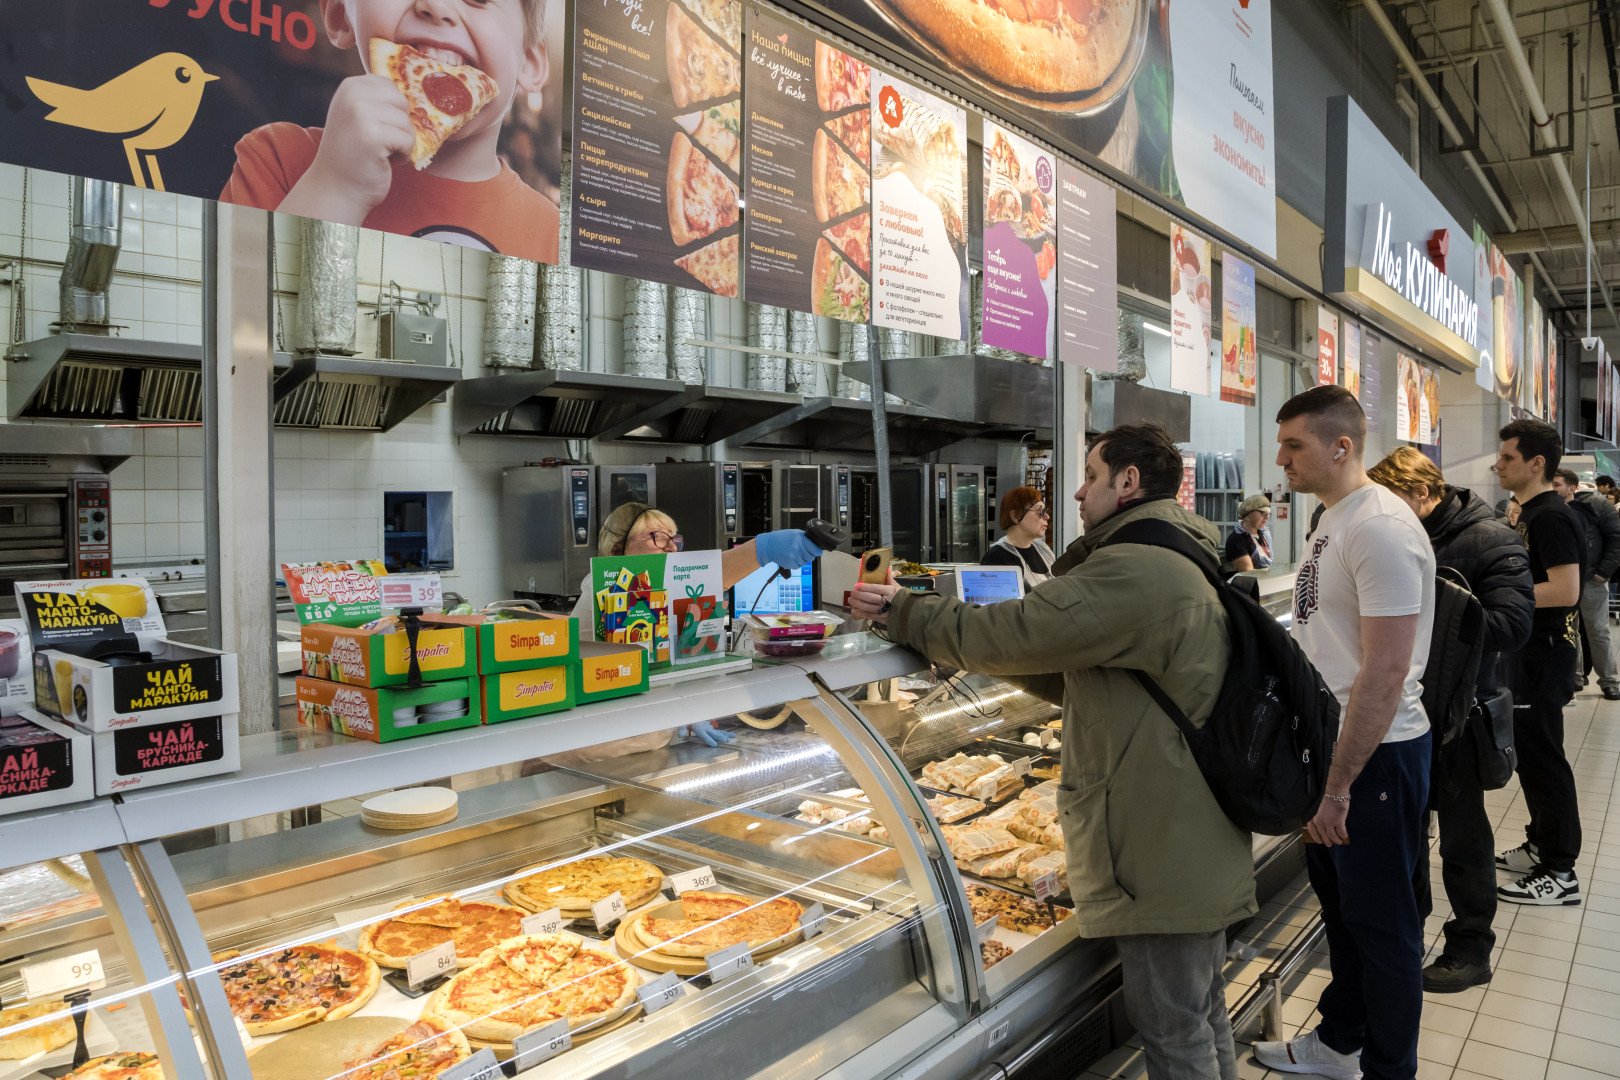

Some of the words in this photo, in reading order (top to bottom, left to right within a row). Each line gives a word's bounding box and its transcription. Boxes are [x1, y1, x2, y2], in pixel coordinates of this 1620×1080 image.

[583, 28, 627, 52] Фирменная
[628, 46, 650, 61] пицца
[583, 38, 608, 54] АШАН
[751, 30, 780, 53] Наша
[781, 44, 812, 68] пицца:
[751, 46, 765, 66] всё
[766, 60, 801, 82] лучшее
[582, 72, 614, 90] Ветчина
[620, 88, 644, 101] грибы
[778, 76, 784, 92] в
[785, 85, 807, 102] тебе
[581, 107, 632, 129] Сицилийская
[1233, 110, 1265, 150] вкусно
[580, 141, 606, 156] Пицца
[751, 144, 773, 157] Мясная
[586, 155, 649, 178] морепродуктами
[1213, 132, 1266, 188] экономить!
[751, 176, 773, 188] Курица
[778, 186, 794, 197] перец
[580, 193, 585, 201] 4
[586, 195, 607, 208] сыра
[750, 208, 782, 224] Пепперони
[579, 227, 621, 246] Маргарита
[879, 217, 884, 227] с
[885, 218, 924, 238] любовью!
[750, 242, 774, 255] Римский
[776, 248, 798, 260] завтрак
[1372, 201, 1403, 294] Моя
[1405, 241, 1479, 347] КУЛИНАРИЯ
[292, 565, 325, 574] Simpatea
[303, 570, 370, 584] ЛИМО-
[603, 570, 620, 581] Карт
[673, 563, 709, 574] Подарочная
[673, 572, 691, 582] карта
[301, 576, 379, 597] НАДНЫЙ
[418, 588, 435, 601] 39
[36, 605, 97, 618] МАНГО-
[39, 612, 119, 629] МАРАКУЙЯ
[510, 633, 555, 650] SimpaTea
[403, 643, 450, 662] Smpatea
[147, 663, 193, 686] ЧАЙ
[595, 664, 631, 682] SimpaTea
[143, 683, 196, 698] МАНГО-
[514, 680, 554, 698] Simpatea
[130, 690, 208, 710] МАРАКУЙЯ
[108, 716, 140, 728] Simpatea
[347, 716, 375, 733] МИКС
[150, 723, 195, 747] ЧАЙ
[137, 740, 209, 760] БРУСНИКА-
[3, 748, 38, 772] АЙ
[142, 750, 202, 770] КАРКАДЕ
[0, 769, 56, 784] СНИКА-
[111, 776, 144, 789] Simpatea
[0, 778, 48, 796] РКАДЕ
[693, 876, 710, 888] 369
[1534, 880, 1554, 898] PS
[611, 900, 622, 912] 84
[541, 921, 557, 935] 369
[72, 962, 92, 979] 99
[438, 955, 450, 969] 84
